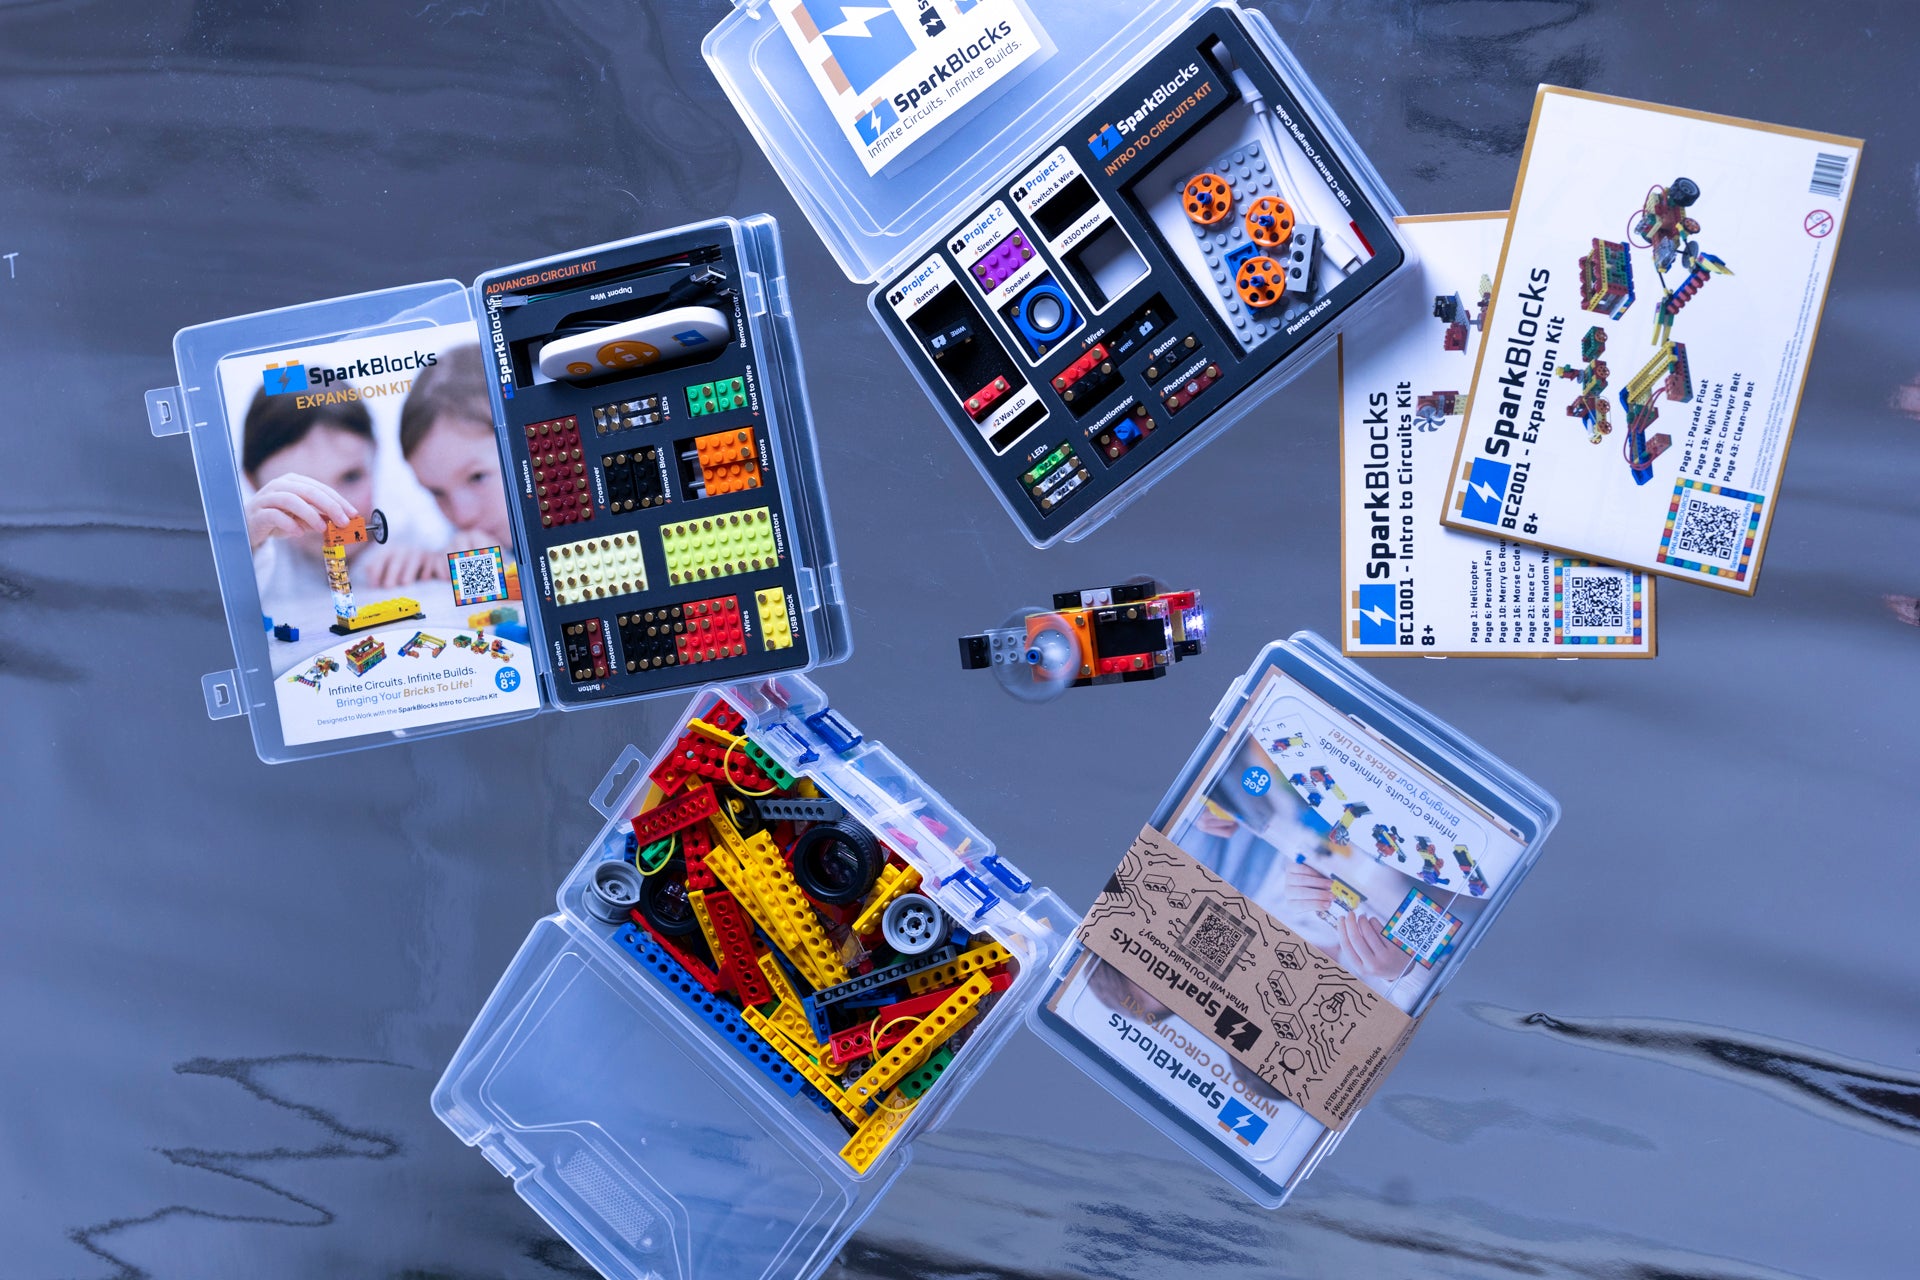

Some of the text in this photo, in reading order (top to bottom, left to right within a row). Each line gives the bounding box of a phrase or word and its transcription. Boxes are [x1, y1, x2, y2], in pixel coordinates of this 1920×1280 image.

[893, 20, 1012, 113] SparkBlocks
[867, 40, 1022, 159] Infinite Circuits. Infinite Builds.
[1116, 62, 1199, 136] SparkBlocks
[1104, 81, 1213, 177] INTRO TO CIRCUITS KIT
[1025, 153, 1067, 191] Project 3
[1275, 104, 1352, 207] USB-C Battery Charging Cable
[1031, 168, 1075, 208] Switch Wire
[963, 207, 1004, 244] Project 2
[977, 230, 1002, 254] Siren IC
[1062, 213, 1101, 247] R300 Motor
[485, 260, 597, 296] ADVANCED CIRCUIT KIT
[590, 285, 633, 302] Dupont Wire
[902, 260, 941, 296] Project 1
[916, 282, 940, 305] Battery
[1005, 271, 1031, 295] Speaker
[1286, 298, 1332, 336] Plastic Bricks
[486, 296, 513, 384] SparkBlocks
[1084, 327, 1105, 346] Wires
[1118, 338, 1134, 353] WIRE
[1153, 335, 1178, 357] Button
[309, 350, 438, 387] SparkBlocks
[1163, 356, 1208, 395] Photoresistor
[1484, 267, 1550, 458] SparkBlocks
[295, 379, 413, 410] EXPANSION KIT
[662, 396, 670, 415] LEDs
[746, 364, 759, 411] Stud Wire
[999, 398, 1026, 423] Way LED
[1088, 394, 1134, 434] Potentiometer
[1501, 315, 1565, 531] BC2001 Expansion Kit
[1680, 379, 1709, 473] Page Parade Float
[1708, 372, 1742, 479] Page 29: Conveyor Belt
[1694, 383, 1724, 476] Page 19: Night Light
[1723, 381, 1755, 482] Page Clean-up Bot
[759, 438, 768, 467] Motors
[1031, 443, 1048, 460] LEDs
[521, 459, 532, 493] Resistors
[593, 466, 605, 504] Crossover
[657, 447, 671, 498] Remote Block
[1362, 391, 1397, 580] SparkBlocks
[1395, 381, 1414, 646] BC1001 Intro to Circuits Kit
[1523, 512, 1539, 535] 8+
[1669, 489, 1691, 556] ONLINE RESOURCES
[772, 513, 784, 554] Transistors
[539, 555, 551, 596] Capacitors
[1512, 548, 1521, 572] Code
[1470, 560, 1480, 643] Page Helicopter
[1484, 549, 1494, 643] Page Personal Fan
[1499, 560, 1509, 643] Page 10: Merry Go
[1513, 574, 1521, 603] Morse
[1541, 565, 1550, 603] Random
[743, 610, 752, 633] Wires
[786, 593, 799, 634] USB Block
[1513, 604, 1521, 619] 16:
[1527, 563, 1537, 643] Page 21: Race Car
[603, 619, 617, 669] Photoresistor
[1421, 624, 1436, 646] 8+
[1513, 621, 1523, 643] Page
[1541, 621, 1551, 643] Page
[554, 640, 565, 667] Switch
[328, 665, 478, 697] Infinite Circuits. Infinite Builds.
[336, 678, 474, 709] Bringing Your Bricks To Life!
[499, 670, 516, 680] AGE
[500, 678, 517, 690] 8+
[577, 683, 601, 693] Button
[317, 693, 488, 727] Designed Work SparkBlocks Intro Circuits
[1243, 777, 1263, 793] AGE
[1251, 770, 1269, 787] 8+
[1318, 735, 1458, 842] Infinite Circuits. Infinite Builds.
[1327, 728, 1461, 828] Bringing Your Bricks Life!
[1138, 928, 1170, 954] today?
[1168, 950, 1192, 969] build
[1110, 927, 1221, 1018] SparkBlocks
[1189, 966, 1211, 986] YOU
[1209, 980, 1227, 995] will
[1119, 994, 1145, 1017] KIT
[1225, 991, 1249, 1014] What
[1142, 1011, 1211, 1067] CIRCUITS
[1108, 1012, 1226, 1110] SparkBlocks
[1210, 1063, 1235, 1086] TO
[1333, 1046, 1382, 1112] Works With Your Bricks
[1232, 1079, 1280, 1119] INTRO
[1325, 1064, 1359, 1108] STEM Learning
[1340, 1054, 1388, 1117] Rechargeable Battery
